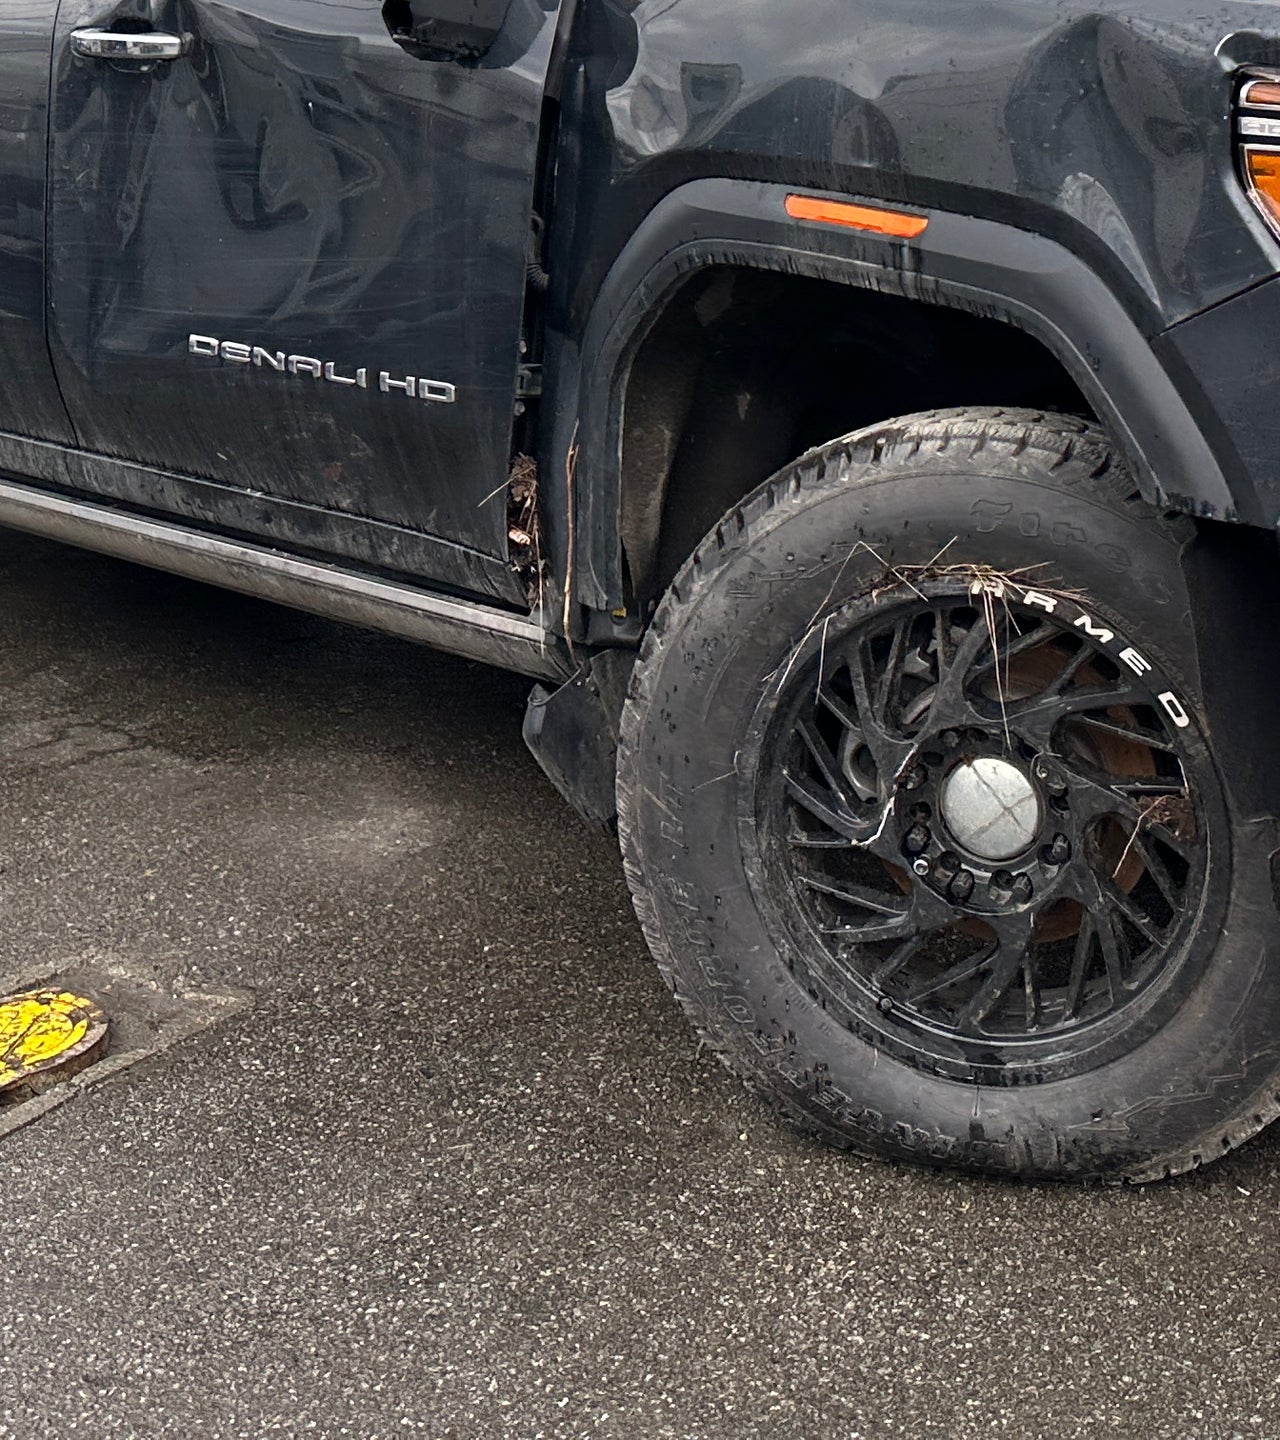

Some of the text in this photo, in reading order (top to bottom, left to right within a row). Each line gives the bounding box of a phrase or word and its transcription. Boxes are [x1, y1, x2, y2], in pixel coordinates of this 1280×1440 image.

[188, 333, 457, 403] DENALI HD
[971, 578, 1190, 728] ARMED
